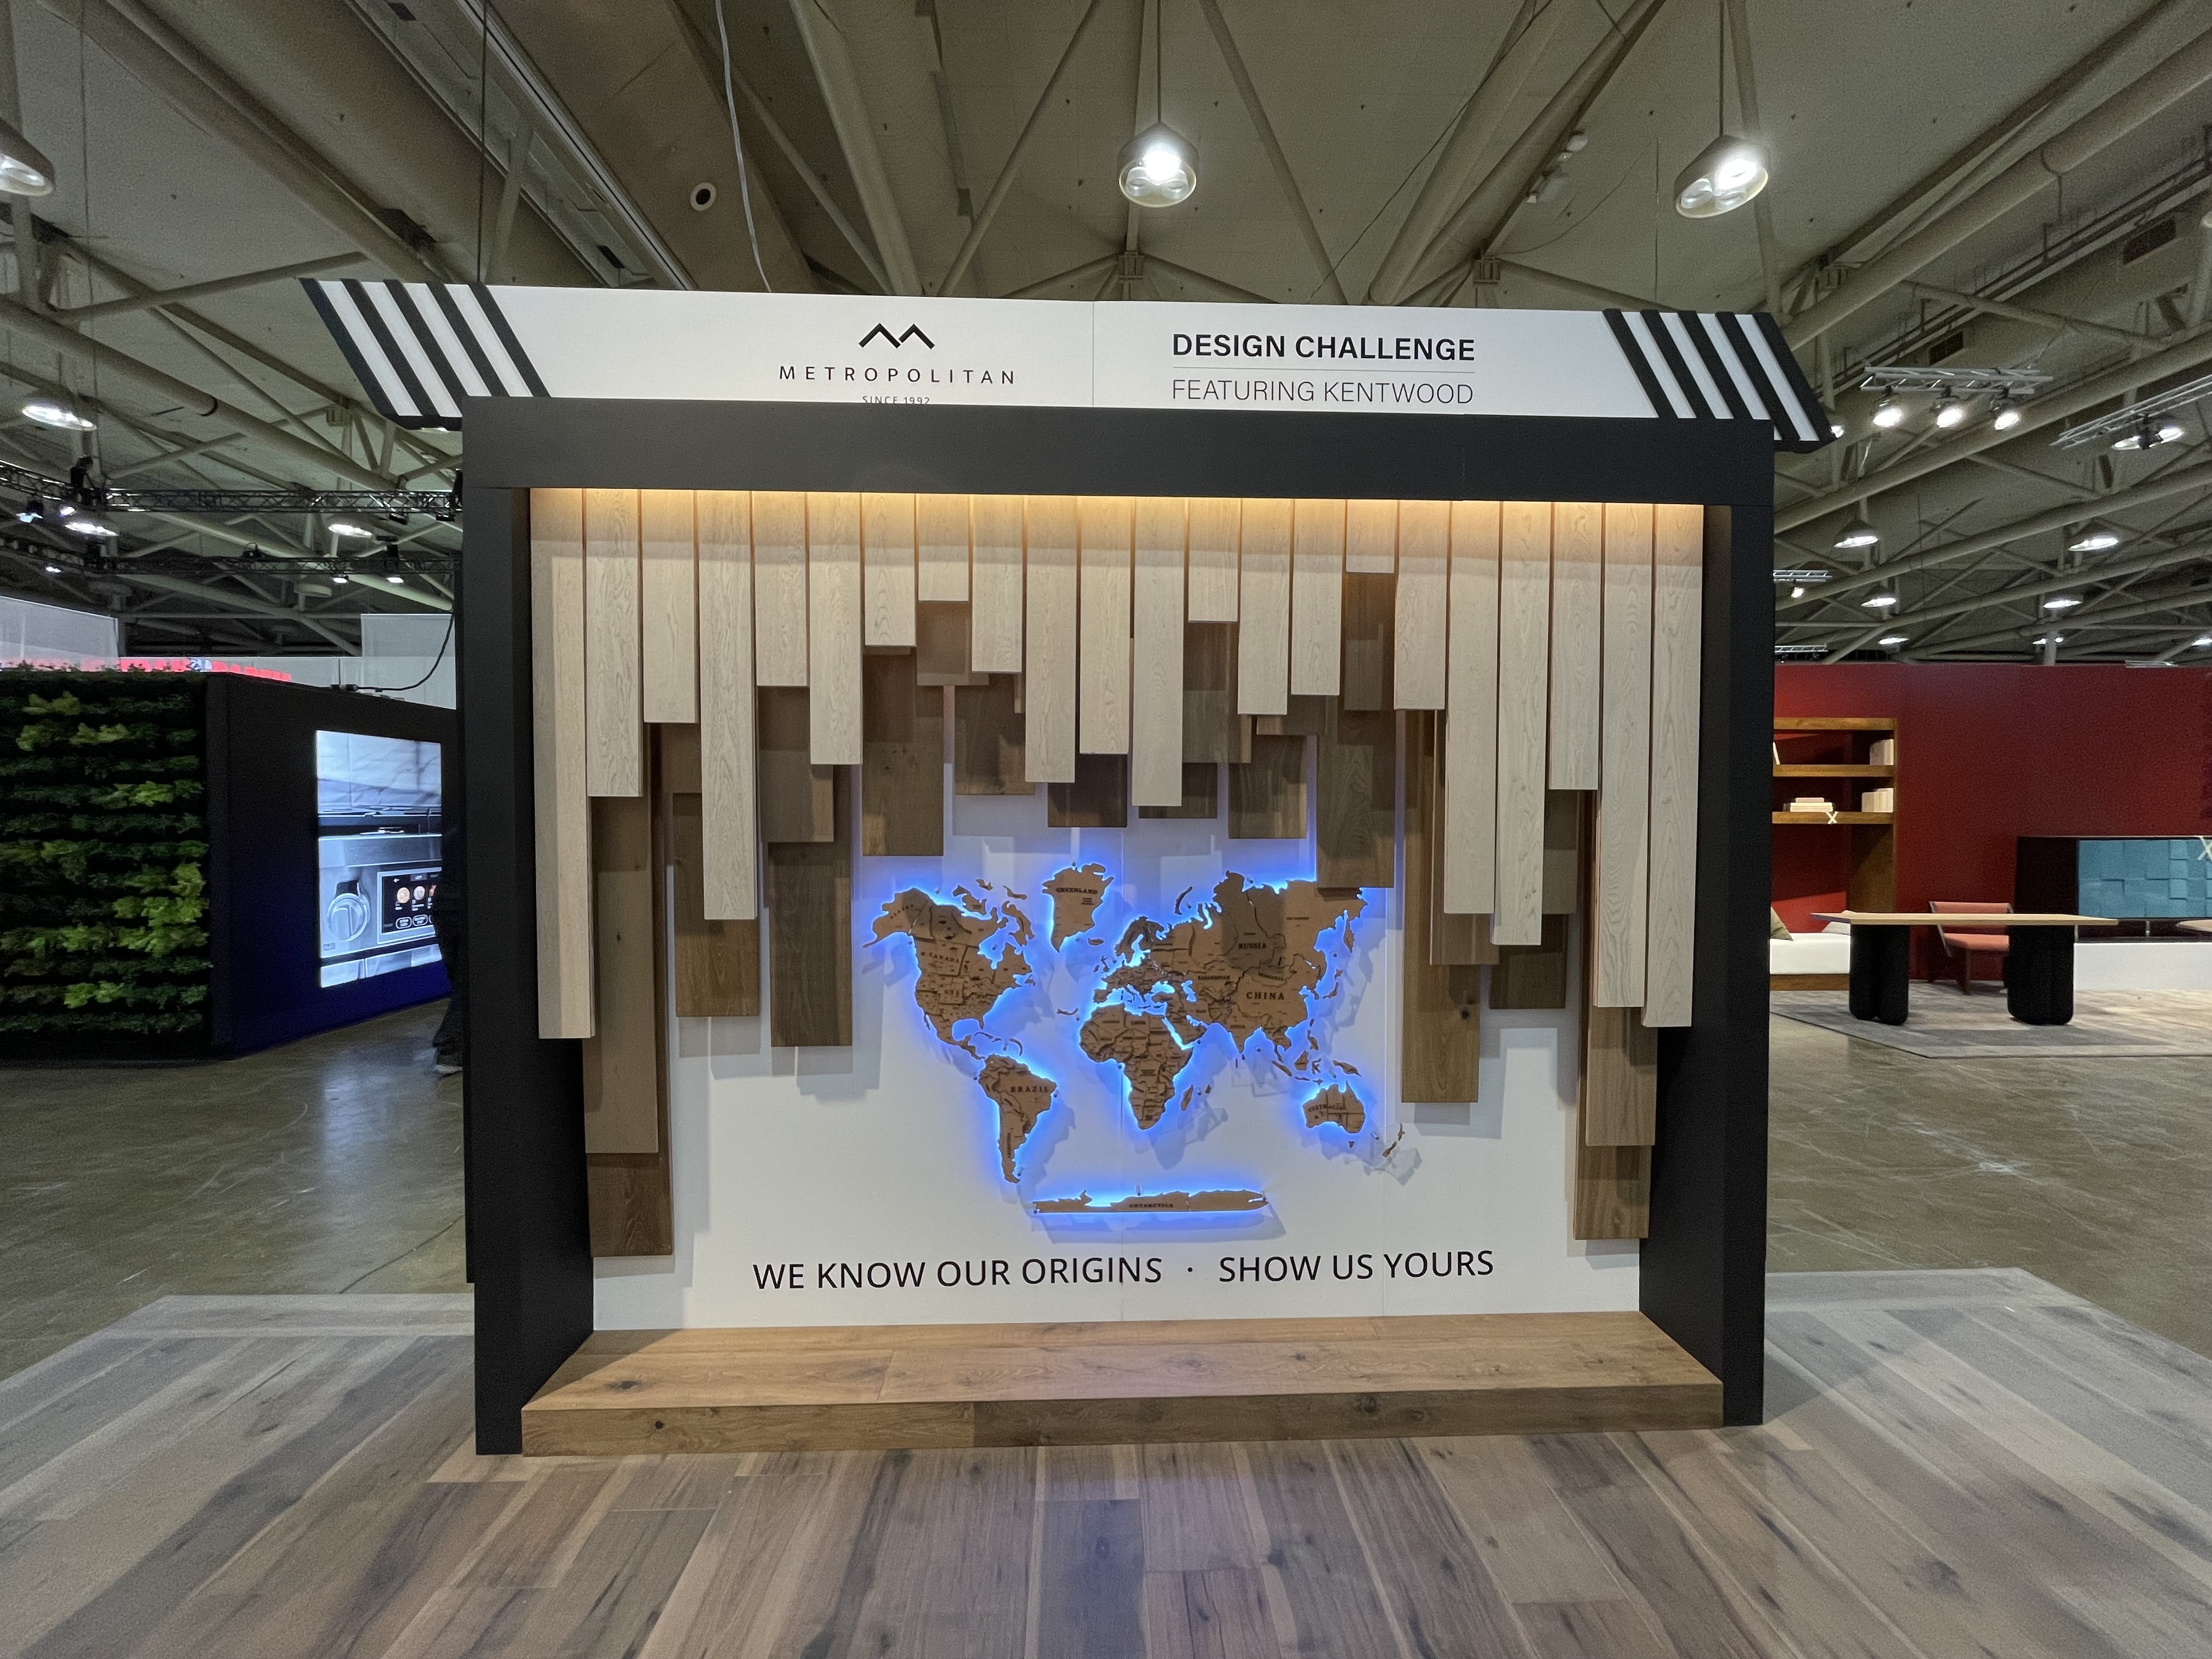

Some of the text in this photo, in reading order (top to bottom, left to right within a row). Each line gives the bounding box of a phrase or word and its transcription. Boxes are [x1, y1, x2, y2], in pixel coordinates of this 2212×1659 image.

[1173, 334, 1475, 361] DESIGN CHALLENGE
[779, 366, 1014, 385] METROPOLITAN
[1173, 380, 1474, 404] FEATURING KENTWOOD
[1056, 887, 1098, 895] GREENLAND
[929, 951, 960, 964] CANADA
[1246, 991, 1285, 1000] CHINA
[1307, 1102, 1346, 1113] AUSTRALIA
[753, 1257, 1162, 1289] WE KNOW OUR ORIGINS
[1219, 1250, 1494, 1282] SHOW US YOURS
